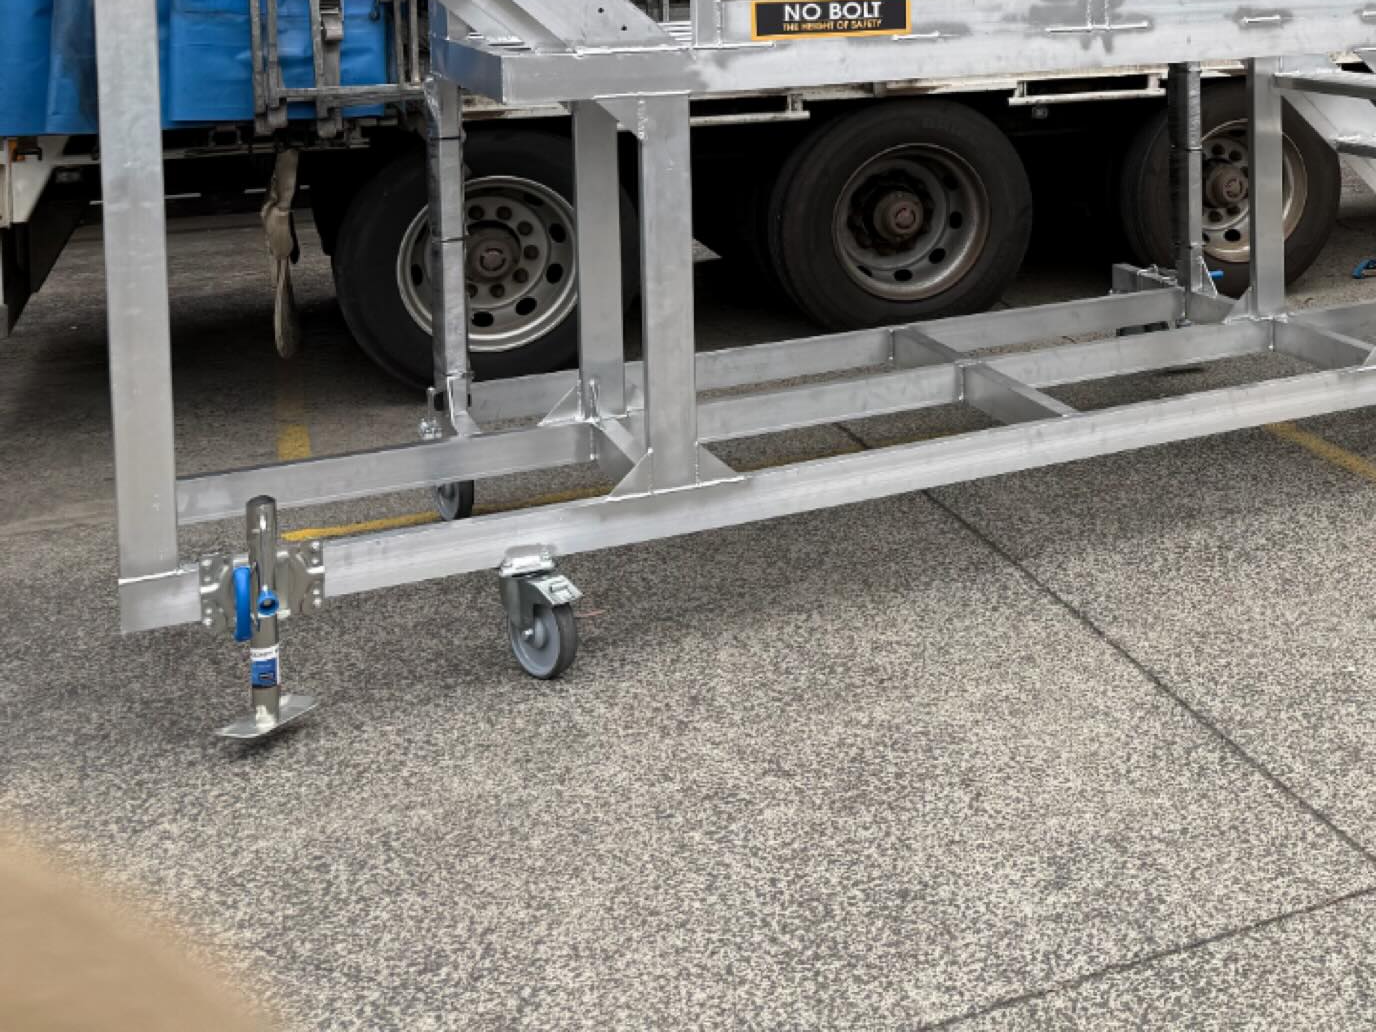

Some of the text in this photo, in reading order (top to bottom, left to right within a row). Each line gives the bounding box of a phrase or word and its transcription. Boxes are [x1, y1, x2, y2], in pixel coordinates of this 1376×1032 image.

[784, 1, 882, 21] NO BOLT
[783, 19, 882, 31] THE HEIGHT OF SAFETY
